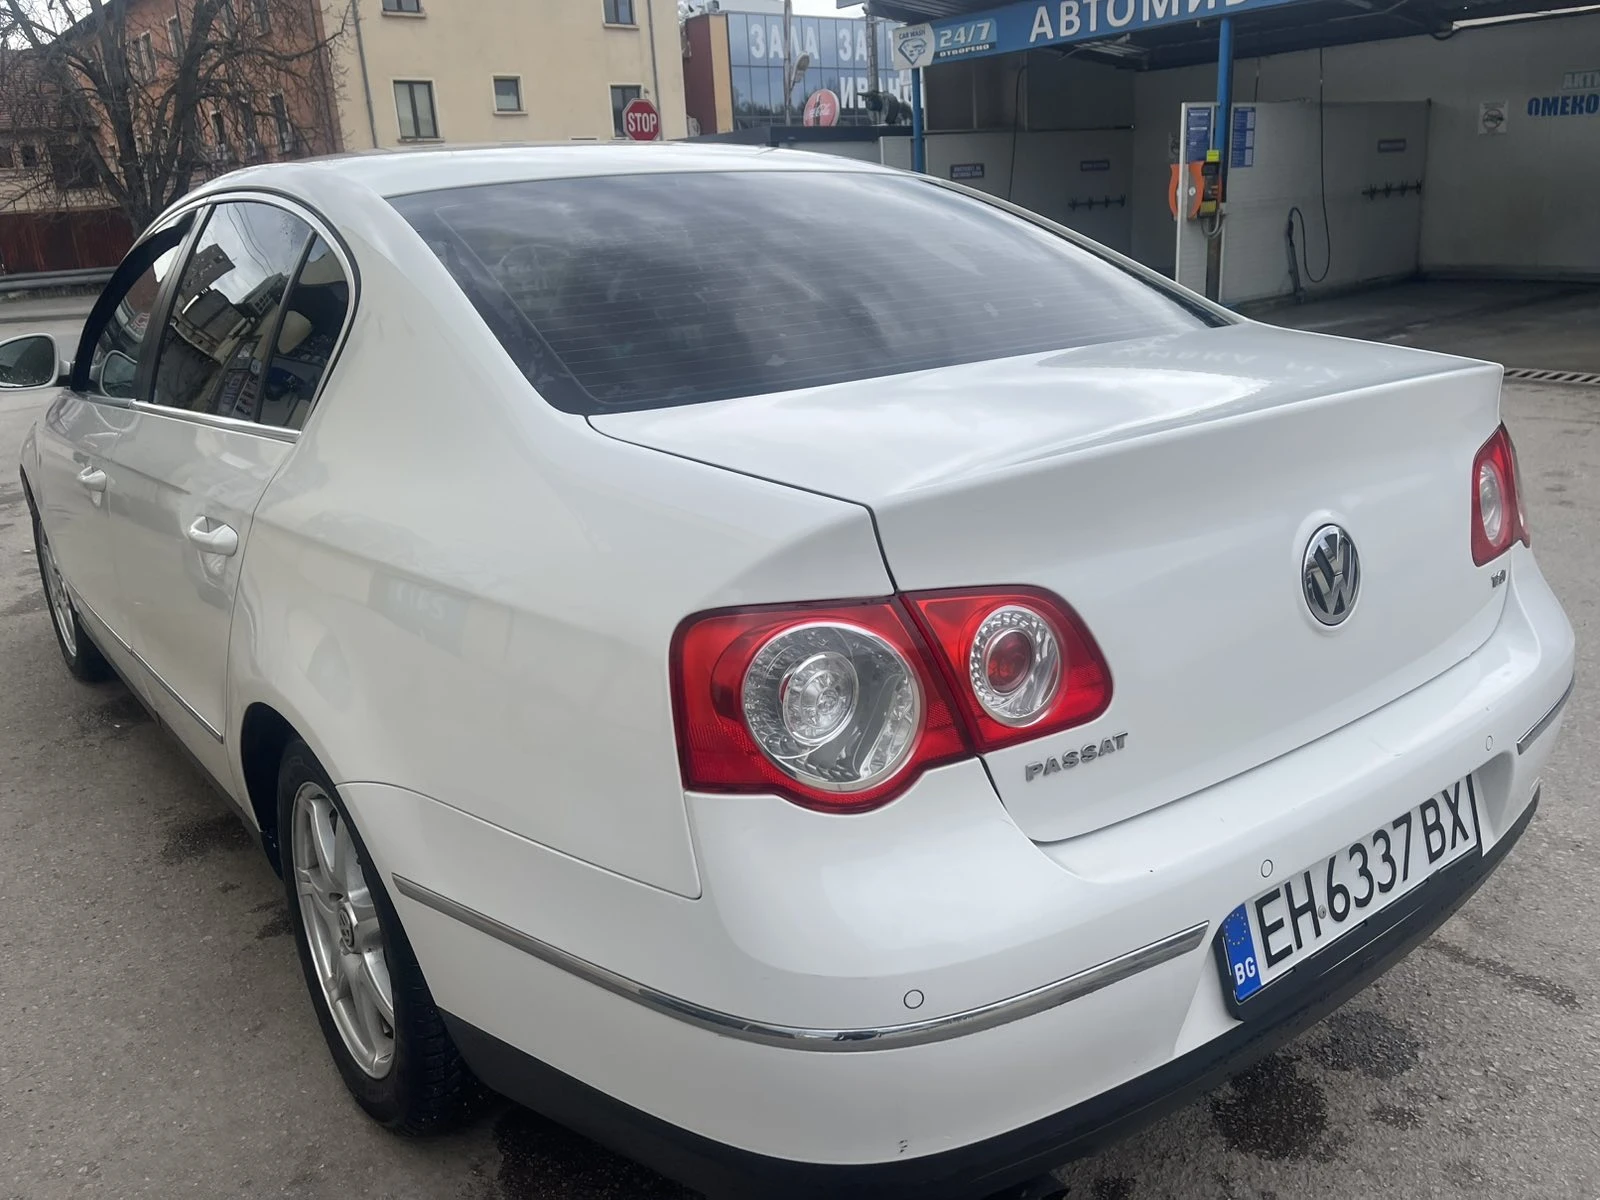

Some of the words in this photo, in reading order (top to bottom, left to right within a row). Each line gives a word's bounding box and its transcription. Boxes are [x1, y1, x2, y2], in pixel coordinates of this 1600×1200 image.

[940, 22, 991, 48] 24/7
[1029, 0, 1246, 43] АВТОМ
[751, 24, 819, 60] ЗАЛА
[838, 28, 868, 62] ЗА
[939, 43, 990, 57] ОТВОРЕНО
[628, 112, 657, 132] STOP
[1025, 732, 1128, 782] PASSAT
[1234, 956, 1256, 986] BG
